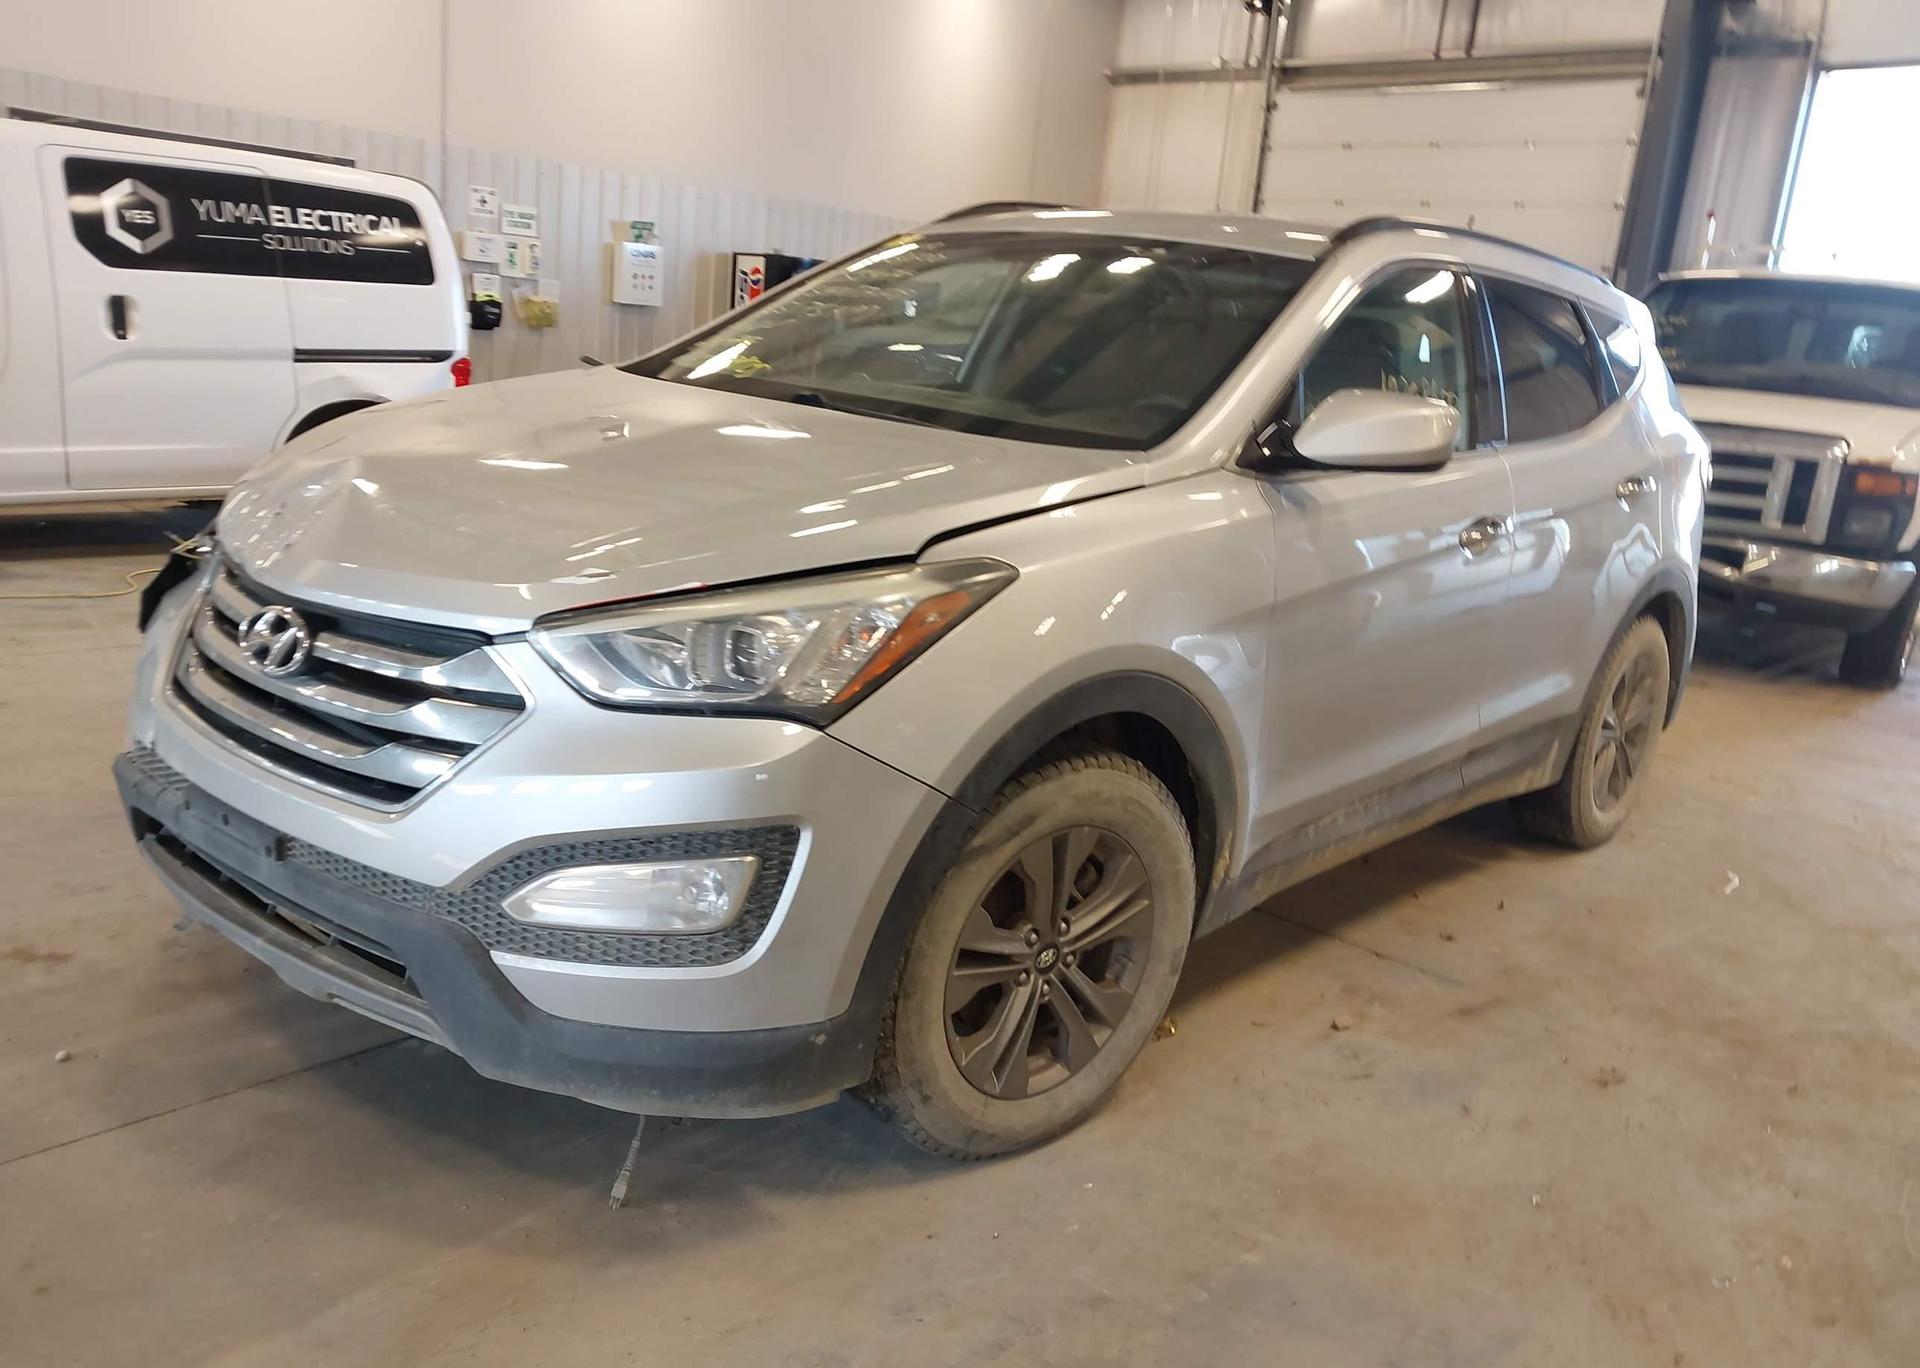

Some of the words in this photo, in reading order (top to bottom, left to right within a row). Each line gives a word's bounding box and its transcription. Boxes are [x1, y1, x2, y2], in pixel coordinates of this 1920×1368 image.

[121, 208, 156, 224] YES
[190, 198, 268, 226] YUMA
[267, 205, 404, 236] ELECTRICAL
[262, 233, 356, 256] SOLUTIONS
